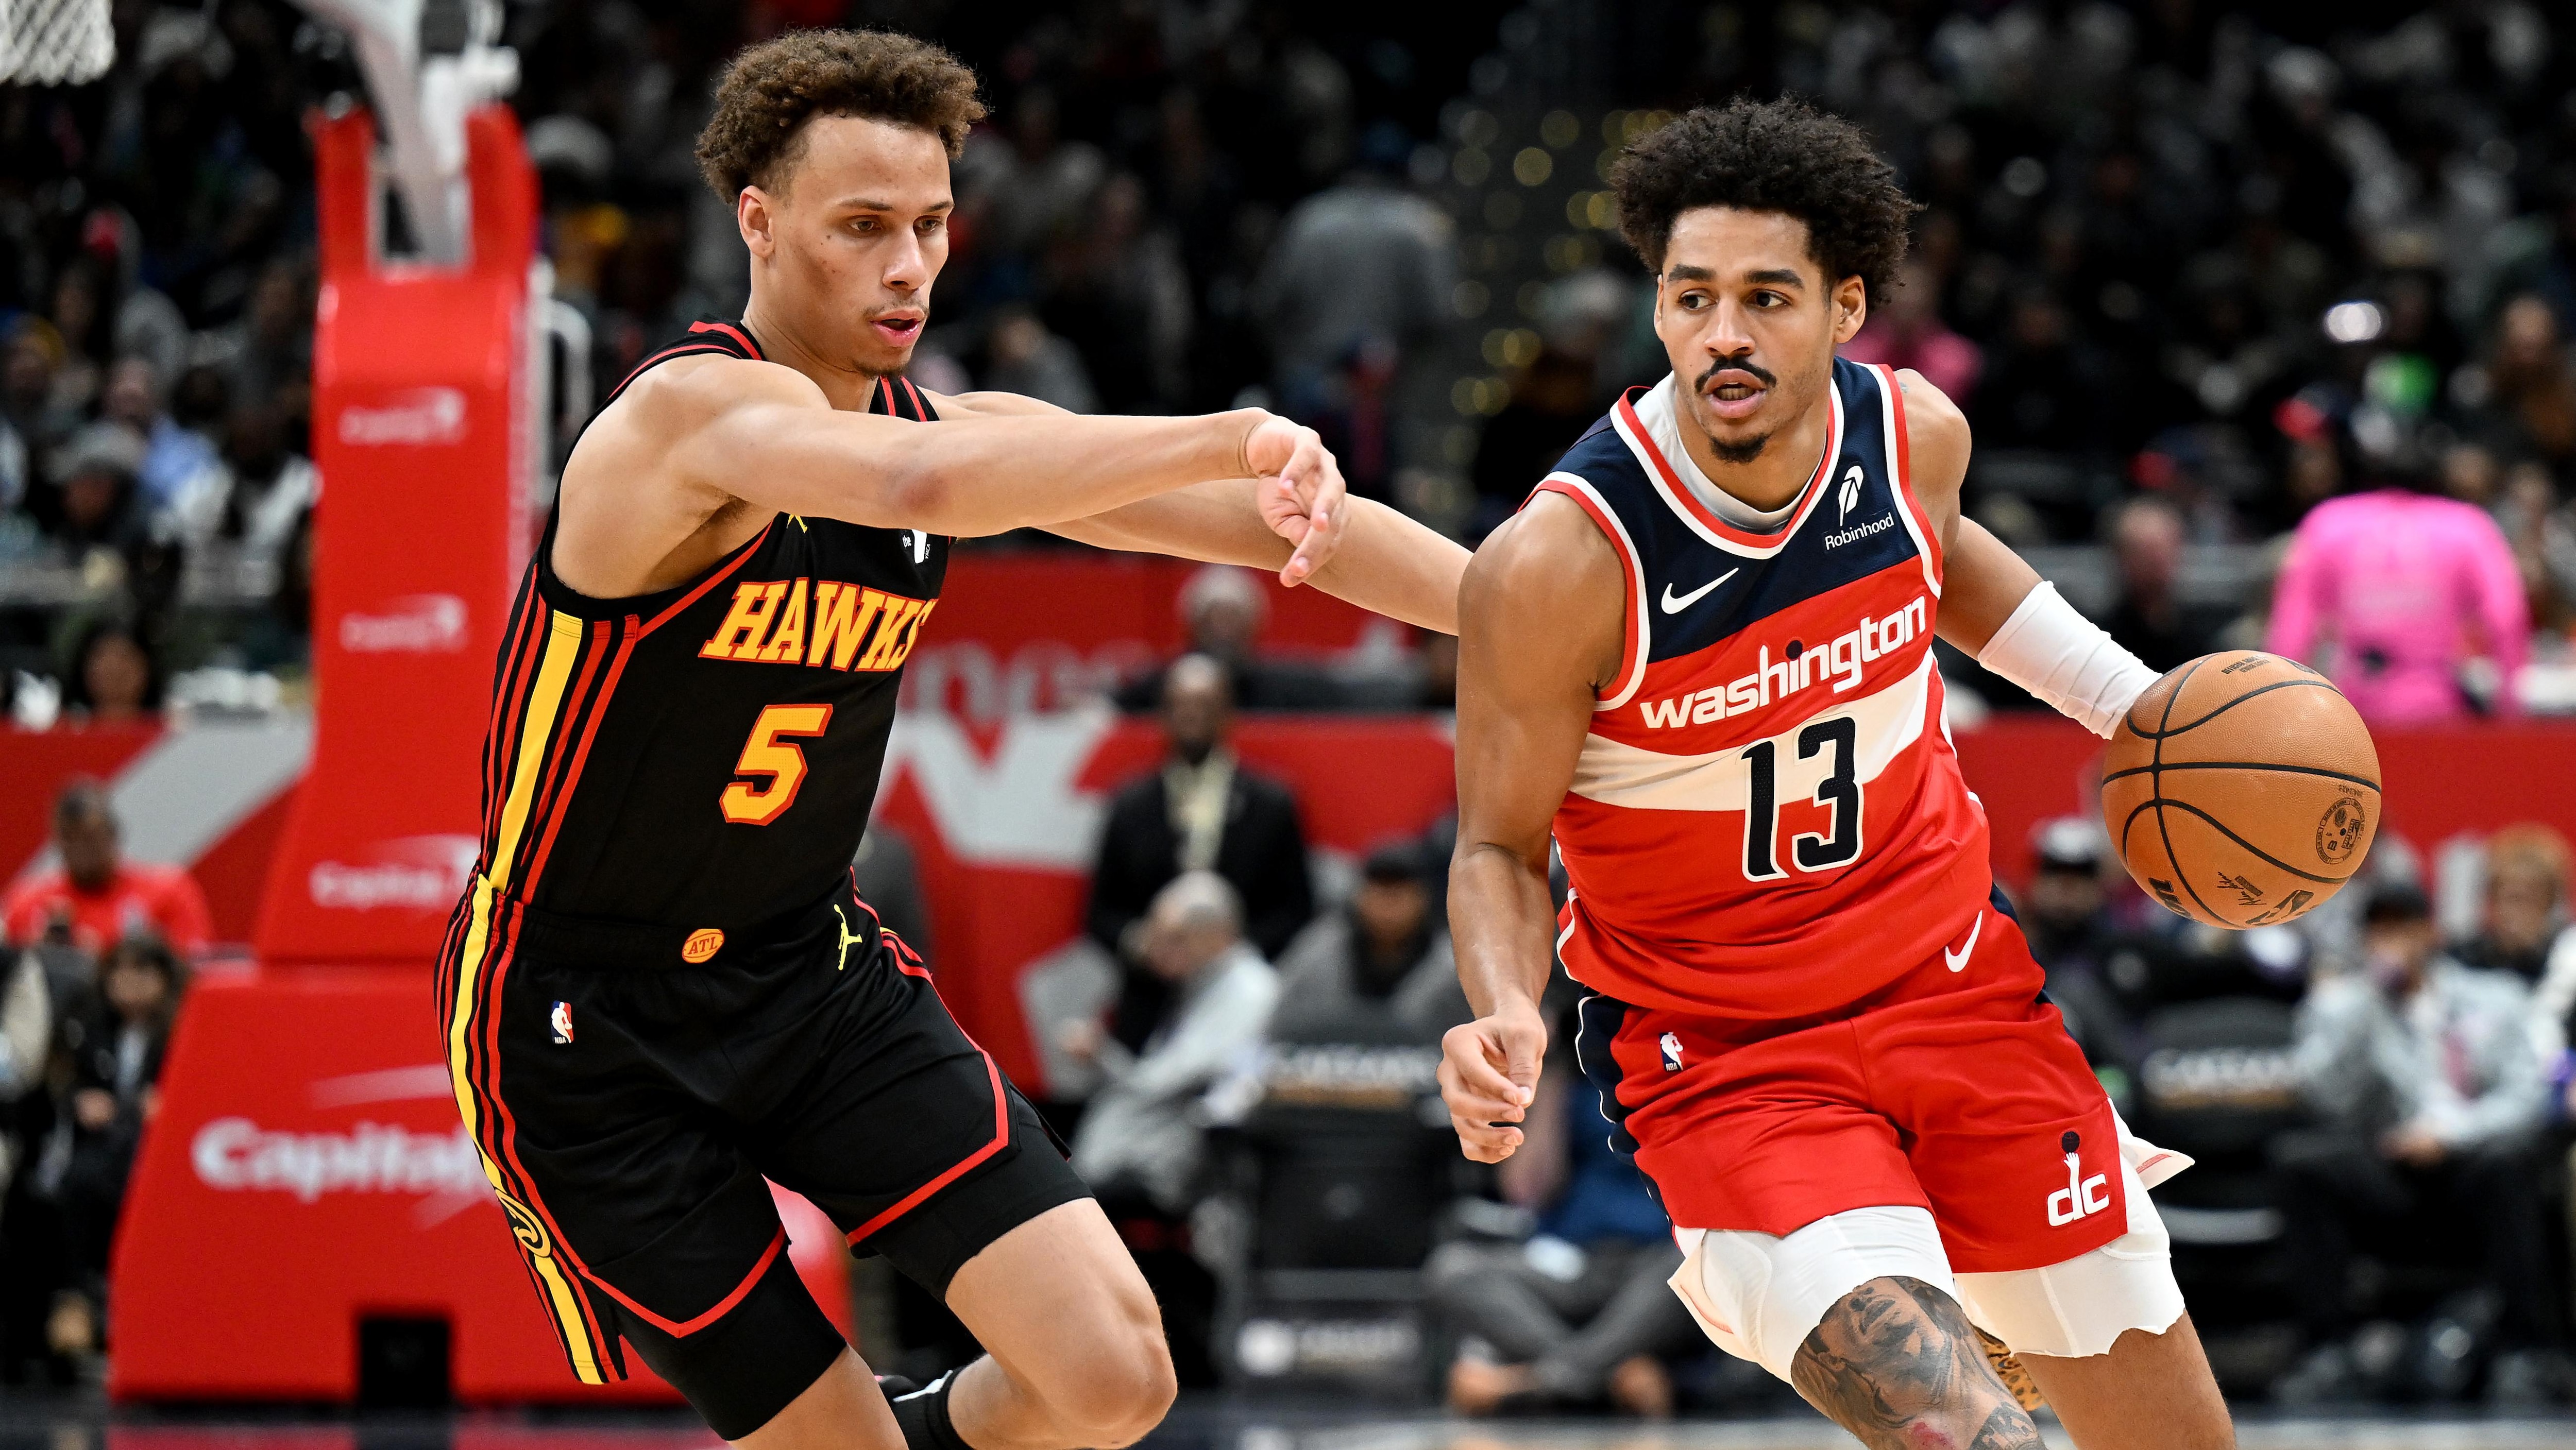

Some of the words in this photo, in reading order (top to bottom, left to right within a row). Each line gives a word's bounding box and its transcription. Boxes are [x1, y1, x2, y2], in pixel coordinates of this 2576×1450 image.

[902, 535, 911, 548] the
[1825, 512, 1894, 550] Robinhood
[698, 577, 939, 671] HAWKS
[1640, 595, 1926, 729] washington
[719, 704, 833, 826] 5
[1741, 716, 1864, 882] 13
[687, 936, 718, 954] ATL
[1666, 1062, 1678, 1071] NBA
[2047, 1152, 2109, 1226] dc
